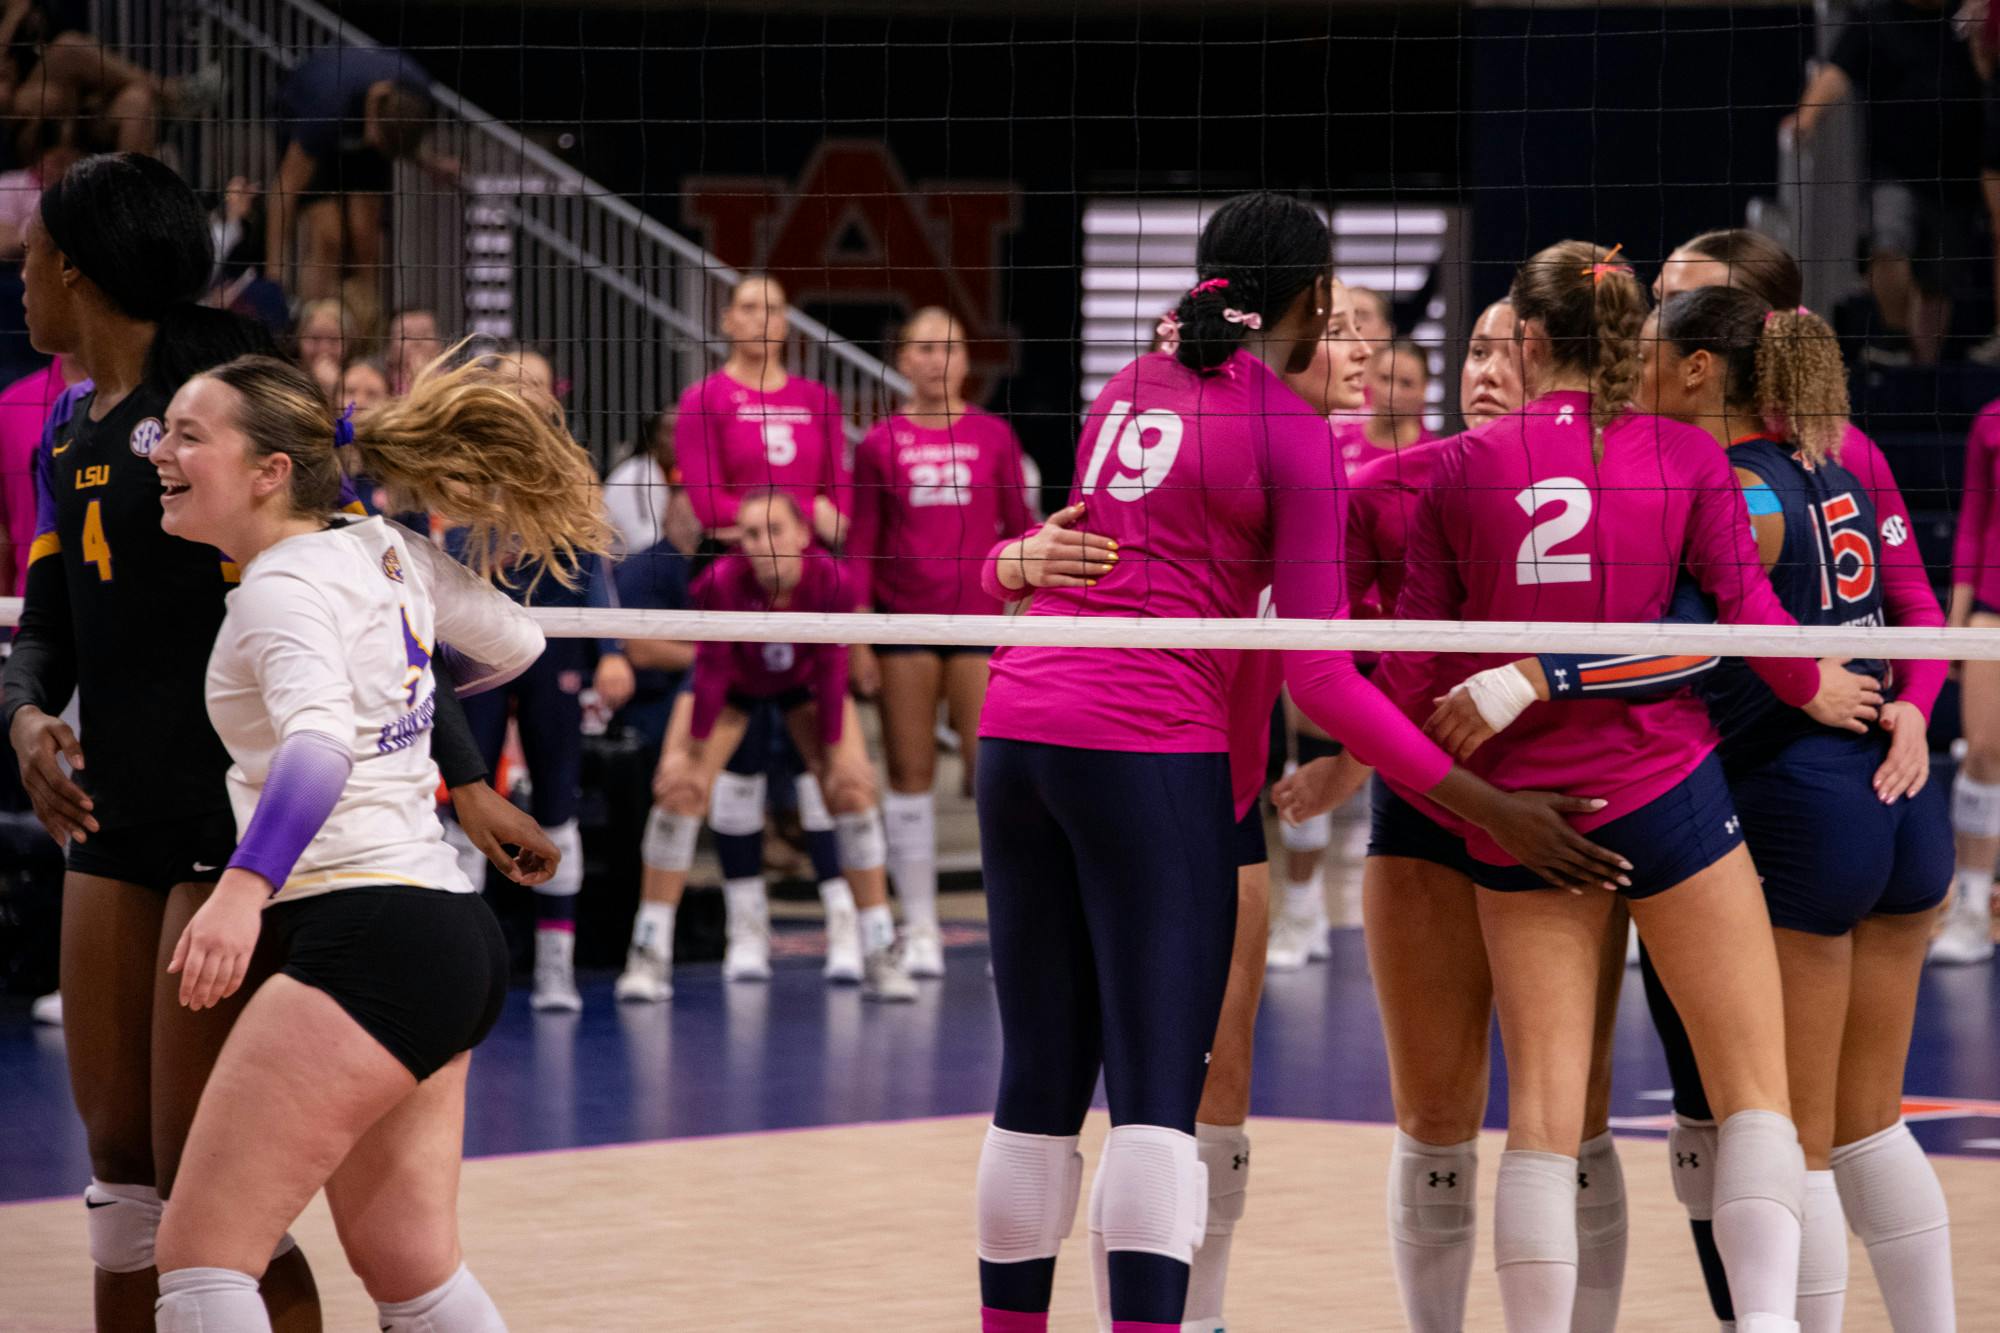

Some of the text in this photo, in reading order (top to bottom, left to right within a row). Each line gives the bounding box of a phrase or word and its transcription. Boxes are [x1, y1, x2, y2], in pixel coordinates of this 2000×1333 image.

[131, 418, 163, 456] SEC
[760, 424, 797, 467] 5
[1082, 400, 1184, 502] 19
[75, 464, 111, 490] LSU
[908, 461, 973, 508] 22
[82, 498, 113, 581] 4
[1515, 476, 1593, 586] 2
[1807, 491, 1876, 611] 15
